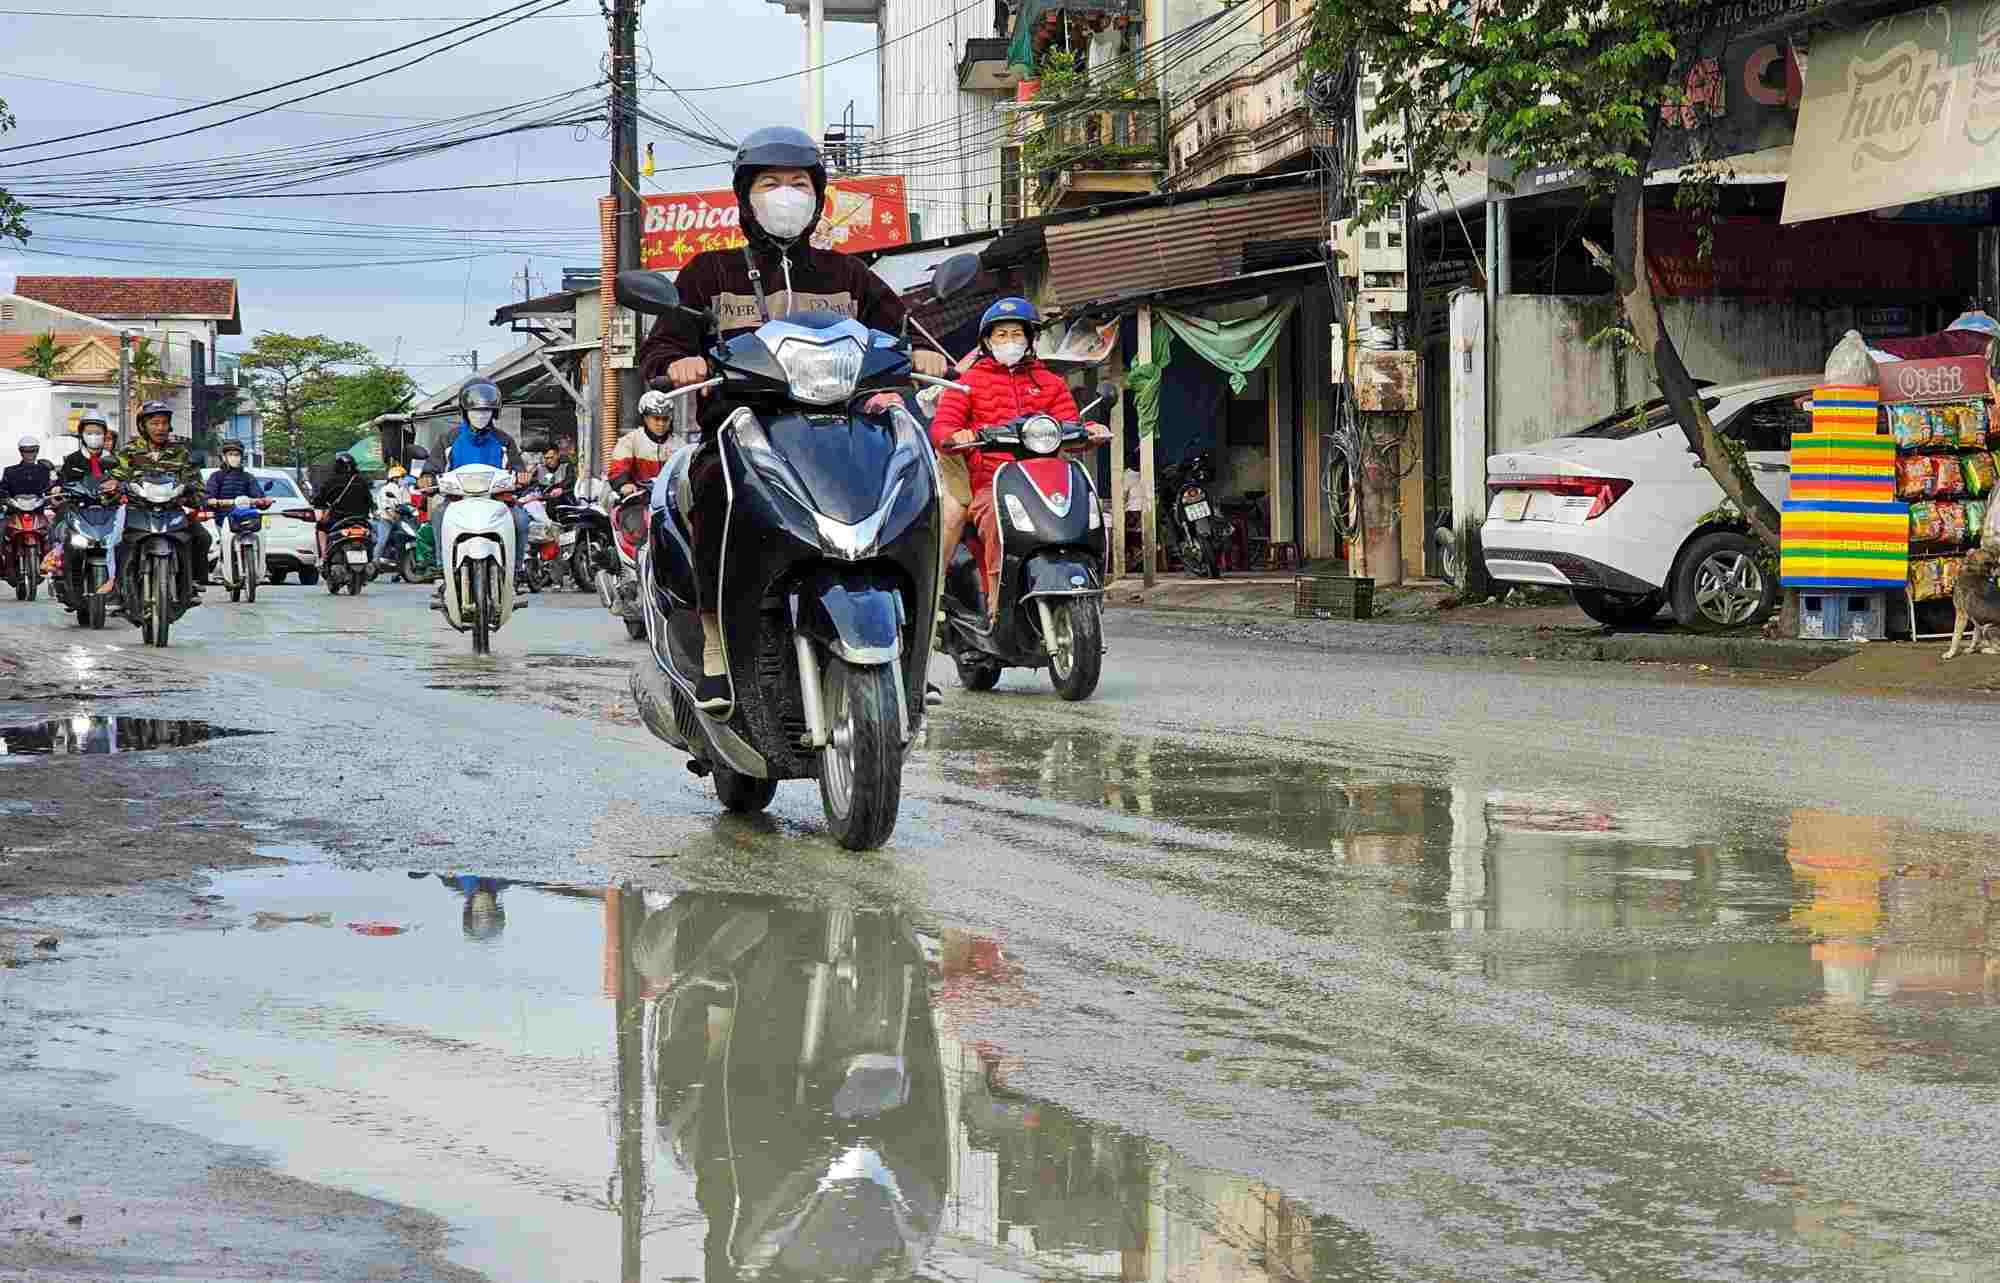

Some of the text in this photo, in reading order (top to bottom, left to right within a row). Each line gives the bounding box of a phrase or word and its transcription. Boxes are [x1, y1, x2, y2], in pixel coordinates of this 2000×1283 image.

[1838, 53, 1952, 144] huda
[645, 203, 741, 232] Bibica
[1898, 366, 1963, 400] Oishi
